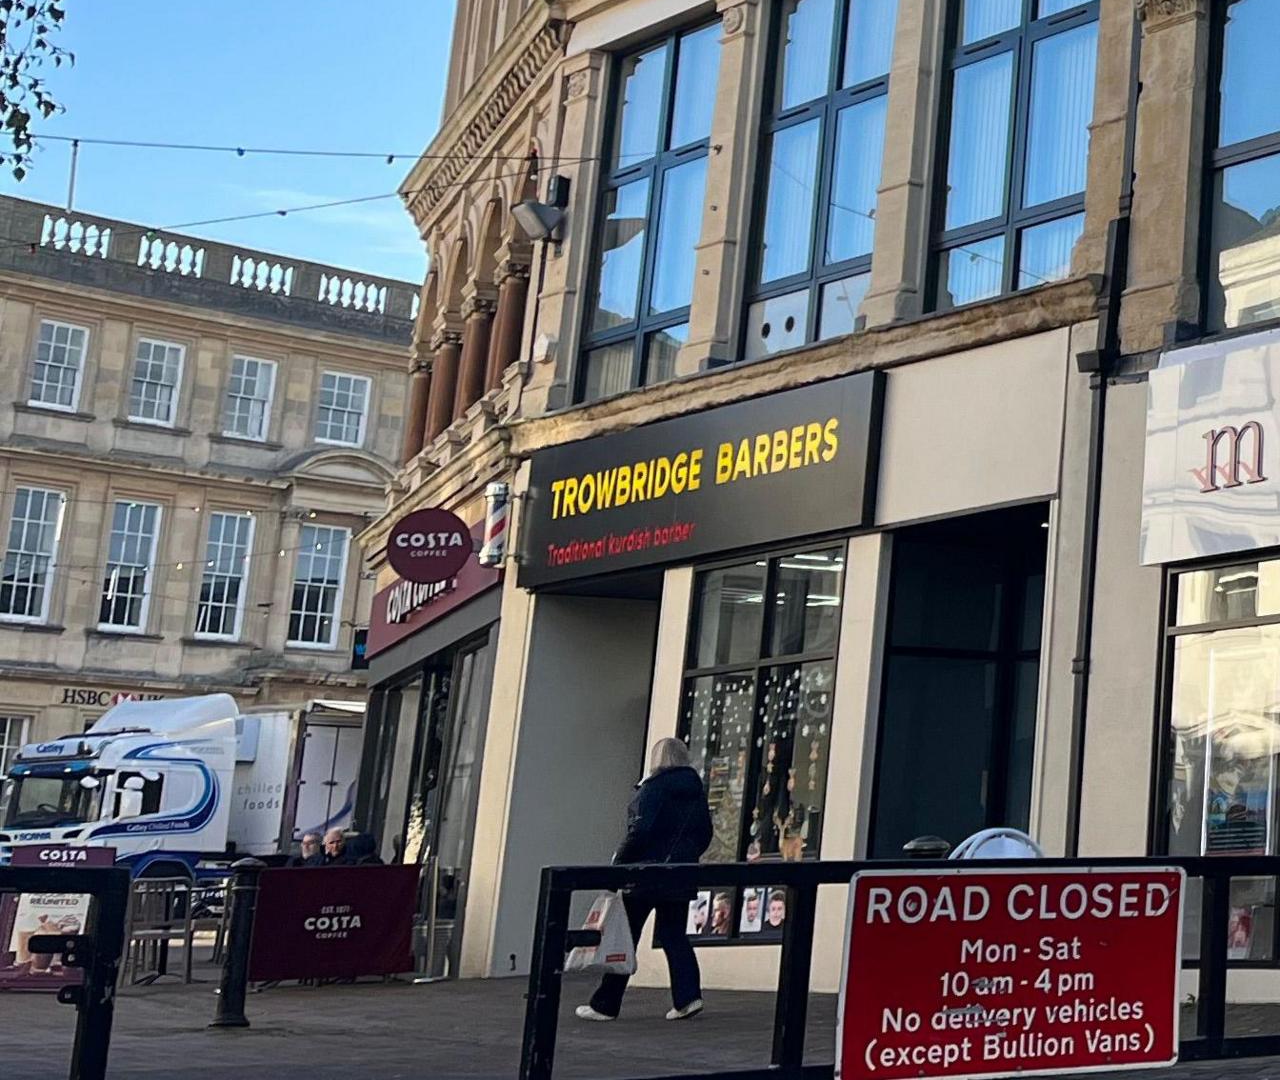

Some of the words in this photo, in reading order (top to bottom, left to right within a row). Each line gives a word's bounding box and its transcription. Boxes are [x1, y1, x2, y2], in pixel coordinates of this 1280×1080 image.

[551, 448, 703, 520] TROWBRIDGE
[715, 418, 839, 485] BARBERS
[396, 533, 462, 548] COSTA
[548, 536, 606, 567] Traditional
[608, 527, 650, 555] kurdish
[654, 521, 696, 546] barber
[61, 688, 111, 707] HSBC
[238, 781, 281, 795] chilled
[243, 798, 280, 810] foods
[40, 849, 87, 861] COSTA
[30, 897, 79, 906] REUNITED
[866, 885, 991, 924] ROAD
[1007, 883, 1170, 920] CLOSED
[304, 915, 361, 931] COSTA
[315, 931, 348, 939] COFFEE
[960, 939, 1017, 964] Mon
[1038, 936, 1081, 961] Sat
[882, 1007, 921, 1033] No
[931, 1003, 1036, 1030] delivery
[1045, 997, 1144, 1025] vehicles
[864, 1036, 972, 1071] (except
[983, 1032, 1074, 1060] Bullion
[1085, 1023, 1155, 1054] Vans)
